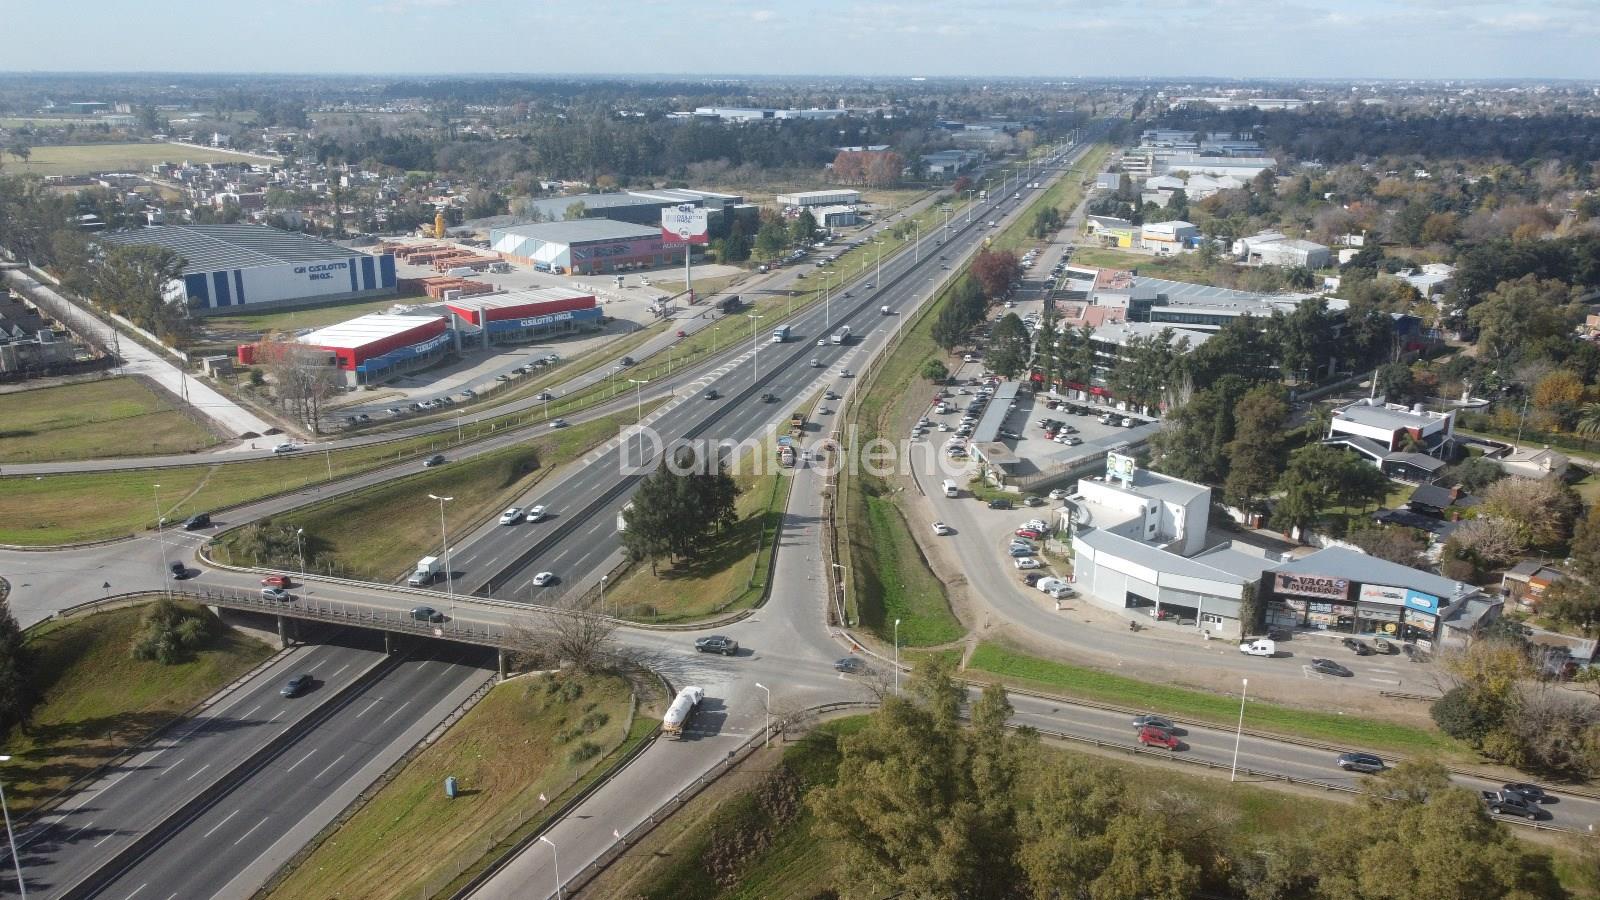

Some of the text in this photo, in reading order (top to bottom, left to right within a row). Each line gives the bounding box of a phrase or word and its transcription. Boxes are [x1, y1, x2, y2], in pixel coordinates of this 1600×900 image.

[309, 262, 347, 273] CISILOTTO
[520, 316, 553, 327] CISILOTTO
[1299, 577, 1334, 588] VACA
